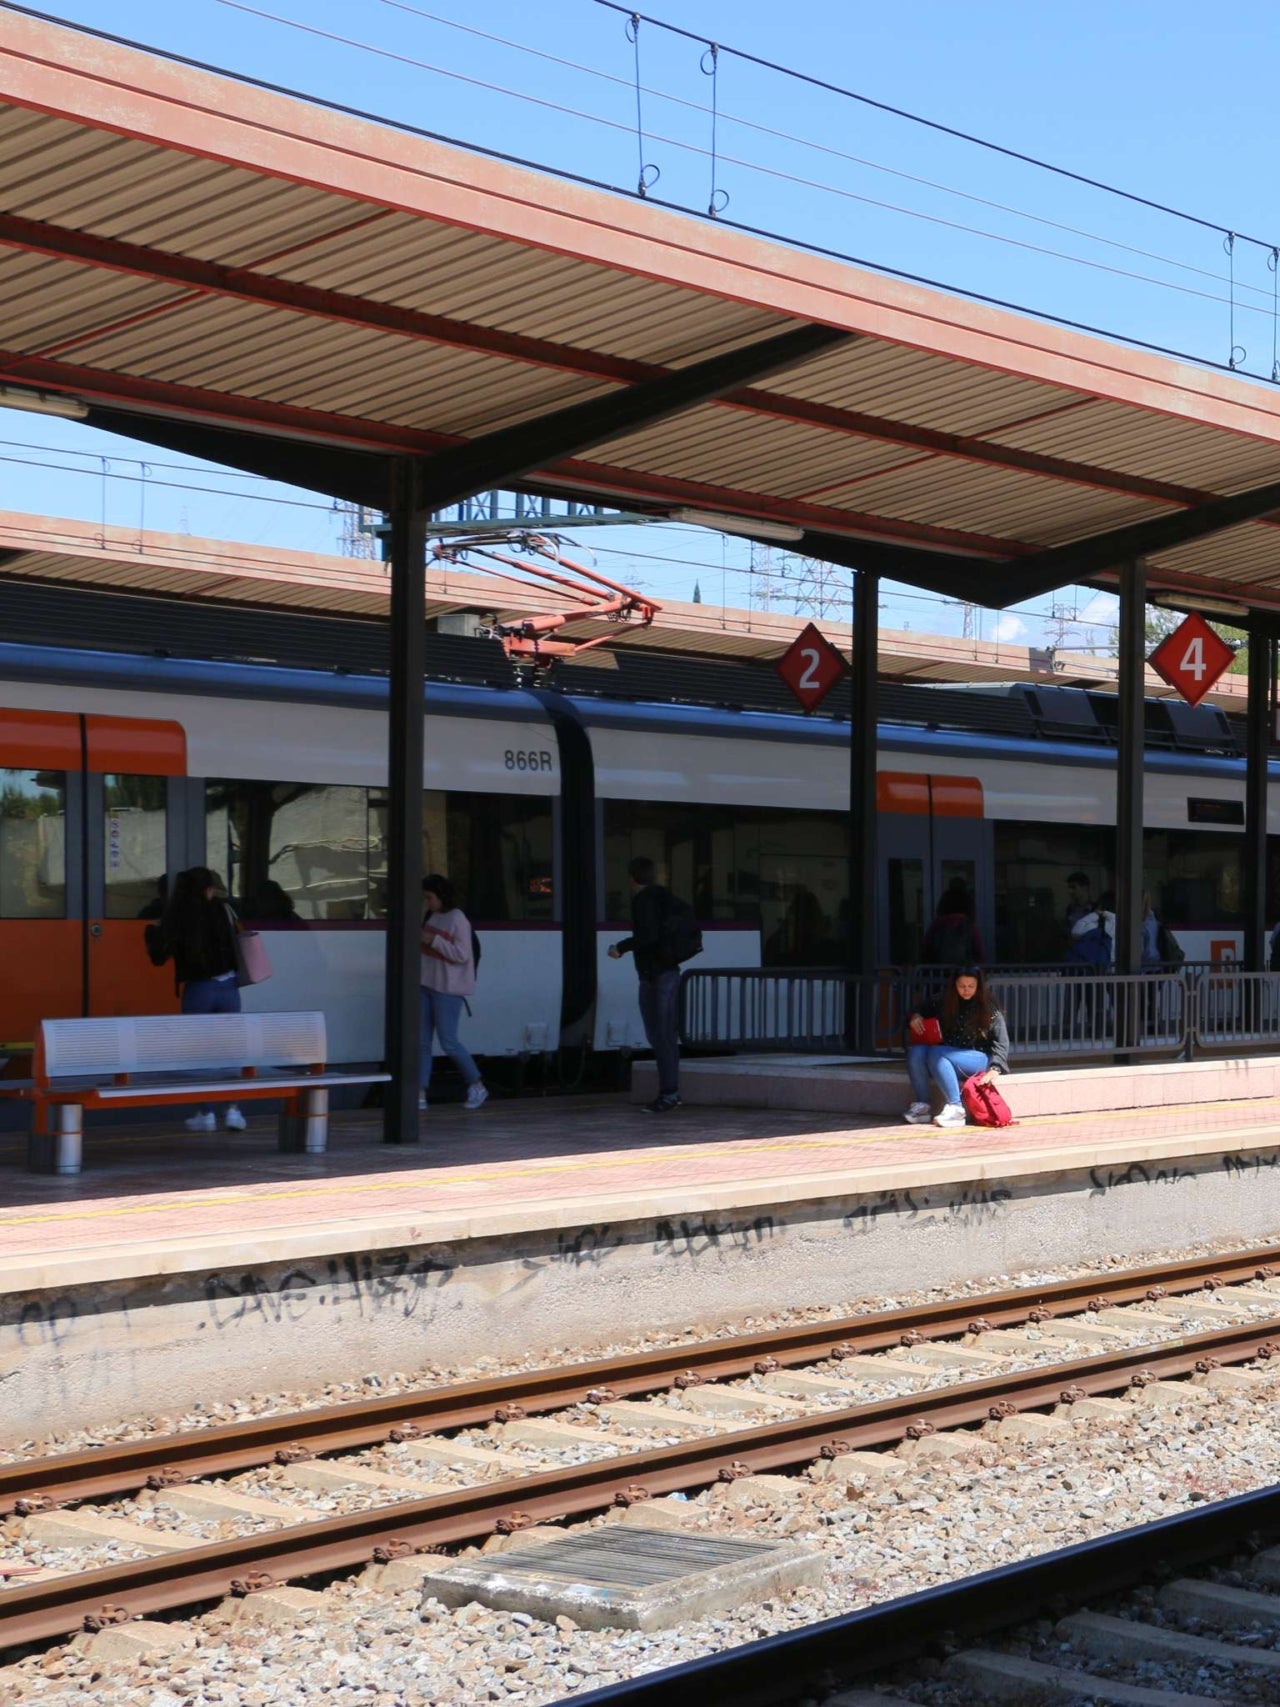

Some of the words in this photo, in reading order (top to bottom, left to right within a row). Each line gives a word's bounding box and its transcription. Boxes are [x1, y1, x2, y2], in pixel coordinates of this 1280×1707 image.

[799, 648, 820, 689] 2
[1180, 637, 1207, 681] 4
[504, 749, 553, 772] 866R
